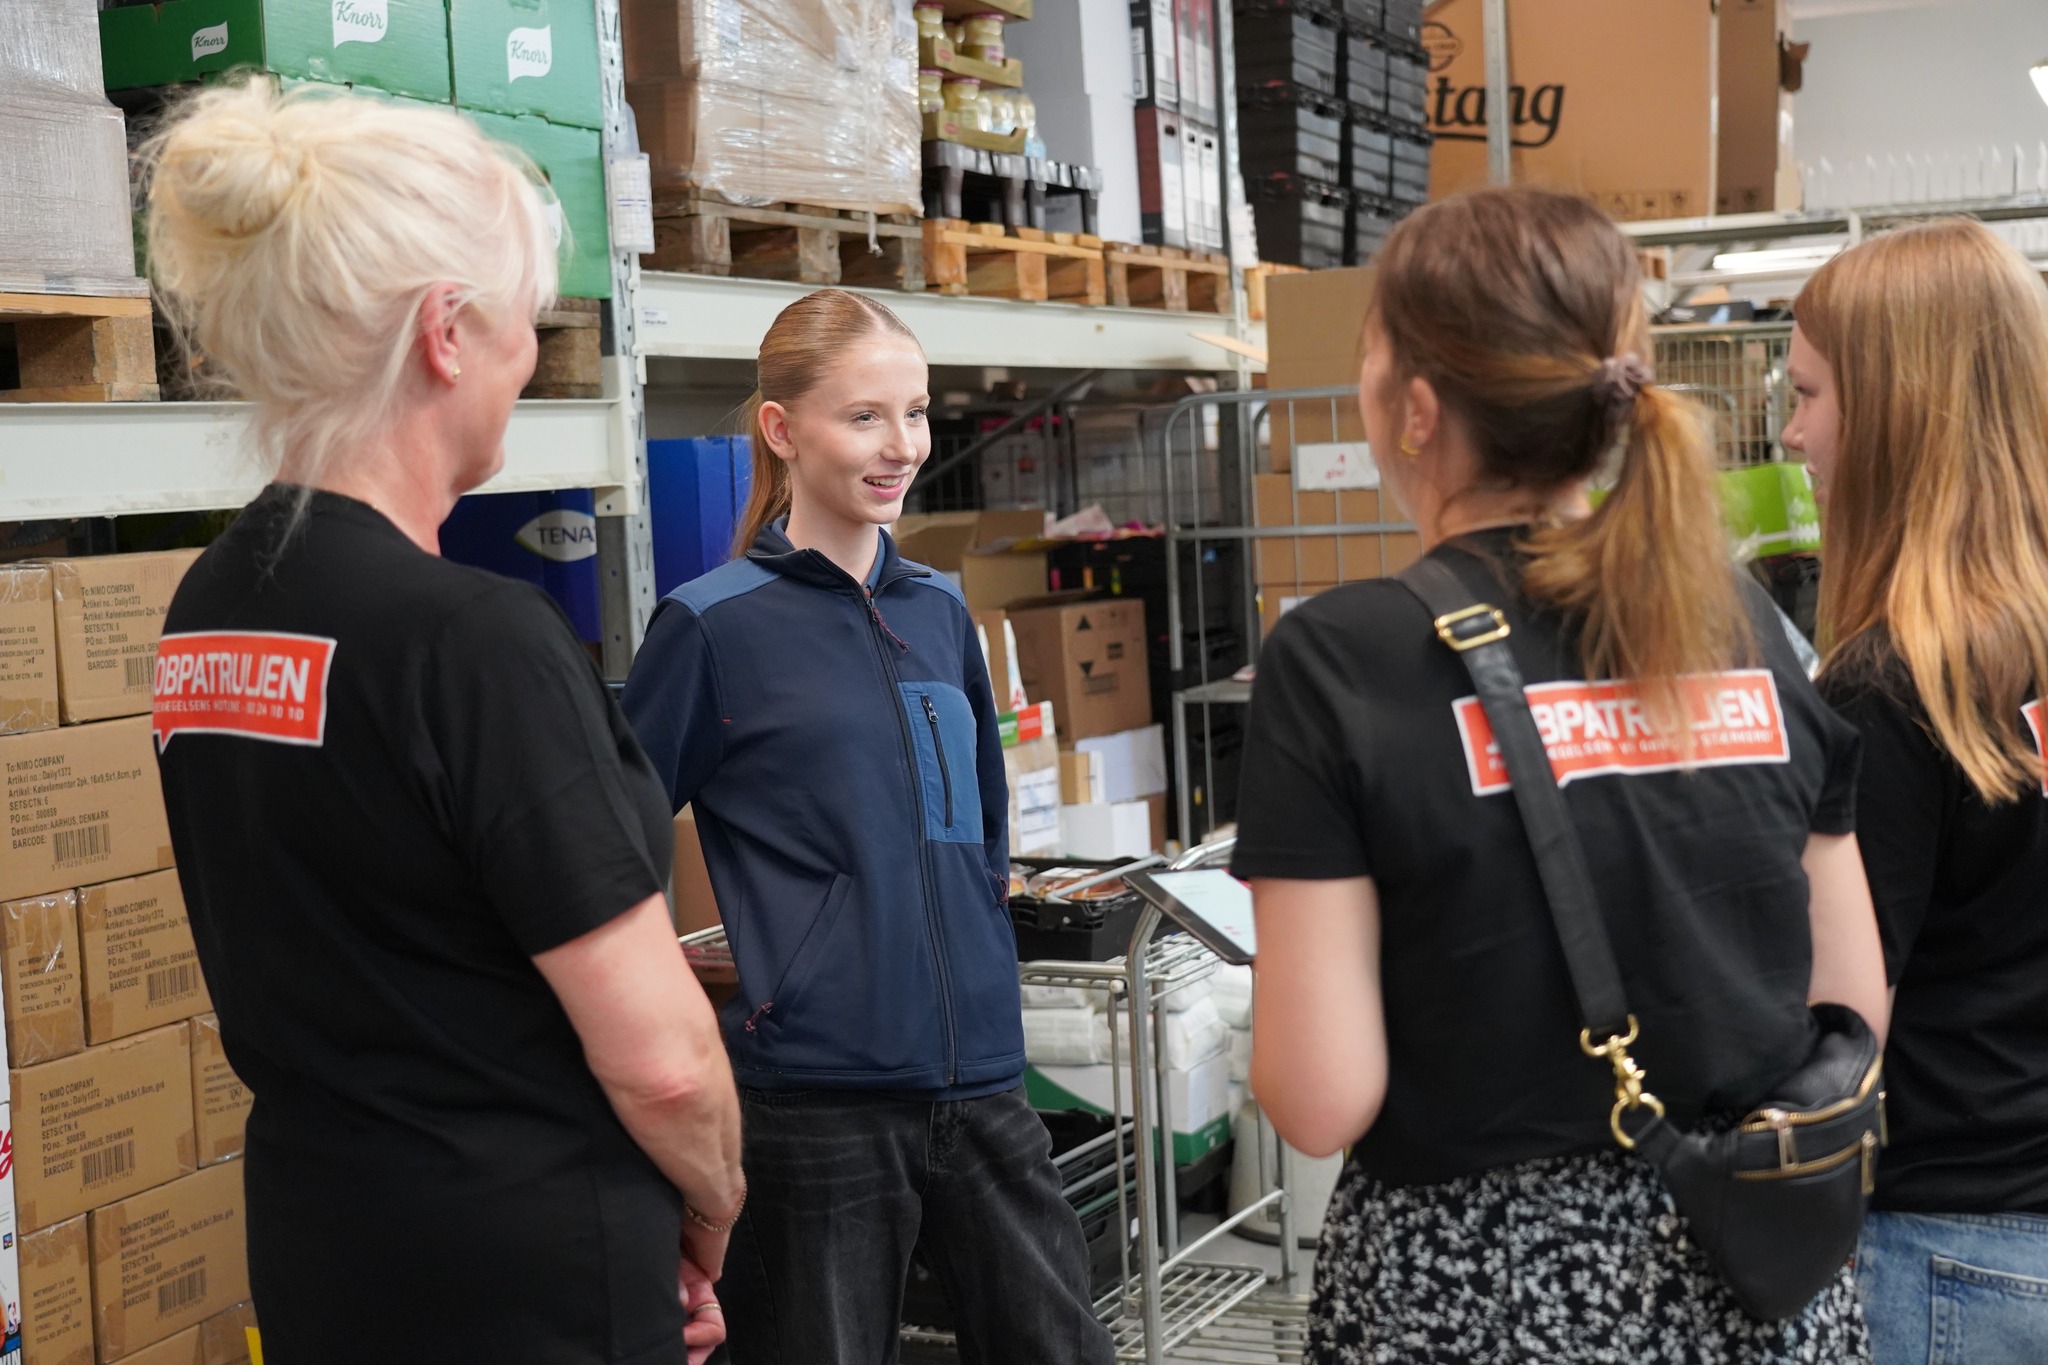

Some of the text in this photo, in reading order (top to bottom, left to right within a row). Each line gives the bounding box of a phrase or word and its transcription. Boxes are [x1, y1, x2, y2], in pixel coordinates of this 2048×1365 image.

[335, 0, 385, 30] Knorr
[194, 35, 226, 48] Knorr
[510, 40, 549, 65] Knorr
[1427, 76, 1566, 148] tang
[536, 525, 595, 546] TENA
[107, 584, 135, 594] COMPANY
[82, 600, 101, 608] Artikel
[86, 636, 94, 646] PO
[155, 652, 311, 703] OBPATRULJEN
[34, 755, 65, 769] COMPANY
[7, 774, 29, 785] Artikel
[42, 767, 71, 780] Daily1372
[132, 768, 142, 779] grå
[45, 796, 49, 805] 6
[10, 814, 21, 823] PO
[11, 823, 49, 836] Destination:
[79, 810, 110, 823] DENMARK
[12, 835, 47, 849] BARCODE:
[130, 898, 158, 912] COMPANY
[105, 920, 125, 931] Artikel
[108, 957, 116, 967] PO
[109, 966, 144, 979] Destination:
[110, 977, 141, 992] BARCODE:
[66, 1078, 94, 1094] COMPANY
[40, 1102, 60, 1115] Artikel
[105, 1127, 134, 1143] DENMARK
[42, 1142, 51, 1152] PO
